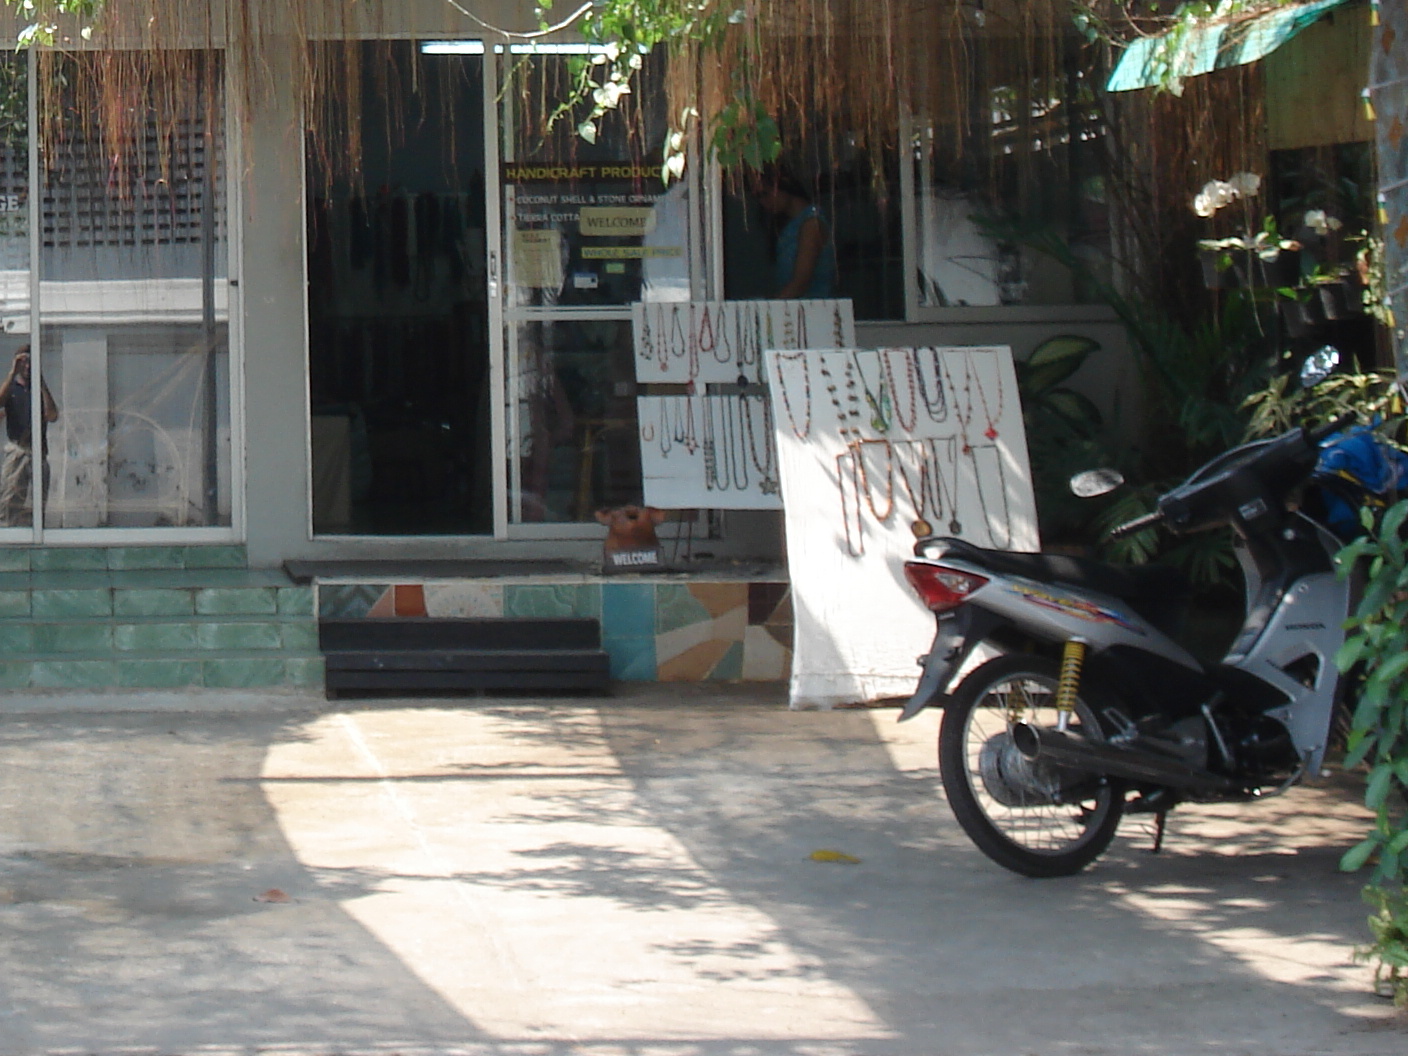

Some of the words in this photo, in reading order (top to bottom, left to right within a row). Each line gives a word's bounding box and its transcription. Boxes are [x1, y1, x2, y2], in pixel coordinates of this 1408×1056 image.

[505, 167, 597, 180] HANDICRAFT
[601, 166, 678, 179] PRODUC
[586, 217, 647, 228] WELCOME
[613, 550, 658, 566] WELCOME
